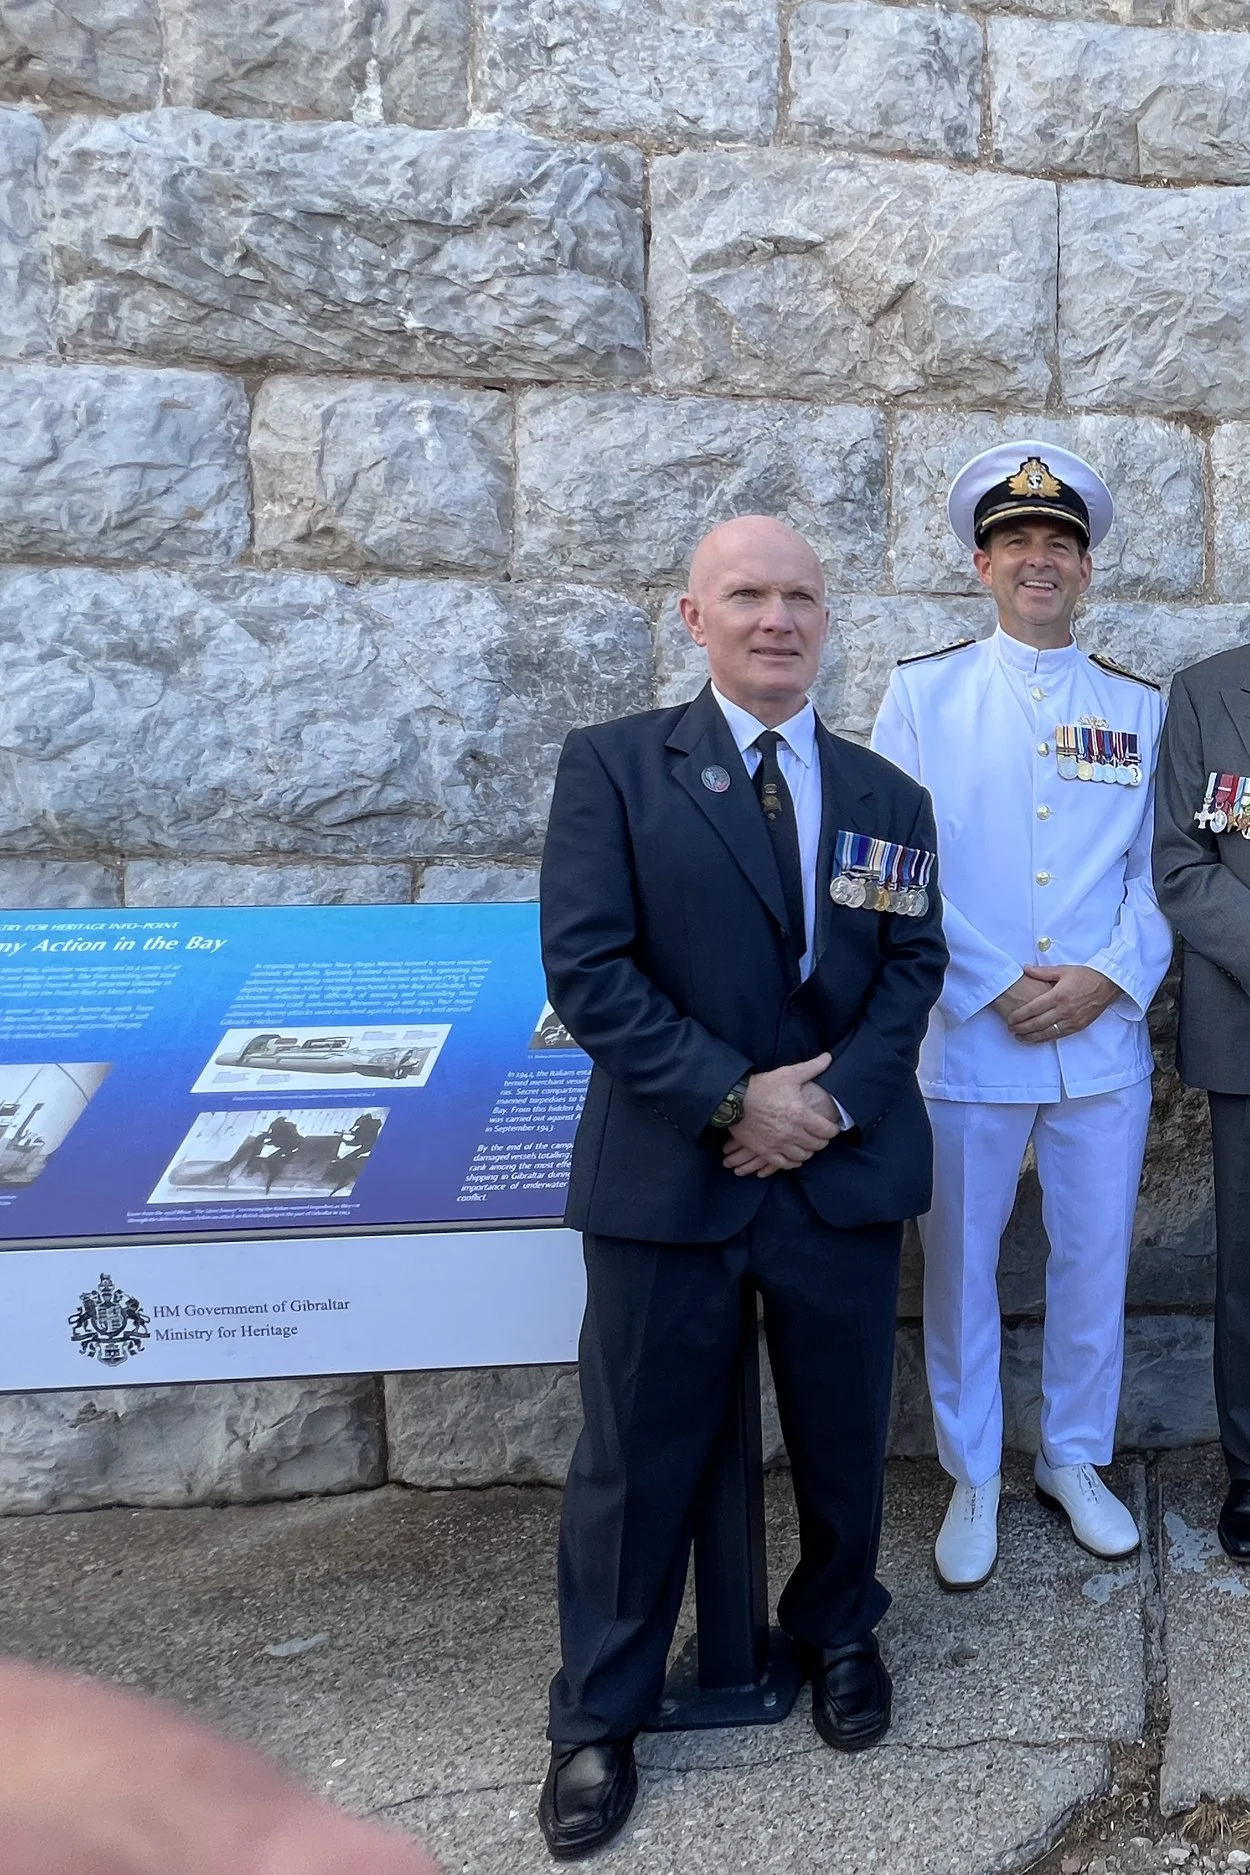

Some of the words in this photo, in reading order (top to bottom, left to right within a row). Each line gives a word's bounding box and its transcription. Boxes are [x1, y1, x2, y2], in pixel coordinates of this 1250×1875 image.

[51, 922, 106, 931] HERITAGE
[31, 937, 107, 953] Action
[113, 936, 136, 951] in
[143, 935, 179, 951] the
[184, 935, 228, 954] Bay
[566, 1077, 590, 1085] vessel
[541, 1087, 588, 1095] compartmen
[494, 1124, 535, 1134] September
[477, 1144, 489, 1153] By
[491, 1143, 504, 1151] the
[506, 1143, 522, 1151] end
[524, 1142, 534, 1150] of
[473, 1152, 511, 1162] damaged
[469, 1164, 487, 1172] rank
[488, 1164, 517, 1172] among
[519, 1162, 533, 1170] the
[534, 1161, 554, 1169] most
[465, 1173, 499, 1183] shipping
[511, 1171, 546, 1179] Gibraltar
[461, 1183, 506, 1193] importance
[510, 1181, 520, 1190] of
[523, 1181, 569, 1189] underwater
[153, 1305, 181, 1318] HM
[184, 1303, 269, 1318] Government
[272, 1299, 288, 1314] of
[289, 1298, 351, 1313] Gibraltar
[155, 1327, 214, 1343] Ministry
[217, 1325, 238, 1339] for
[240, 1324, 299, 1340] Heritage
